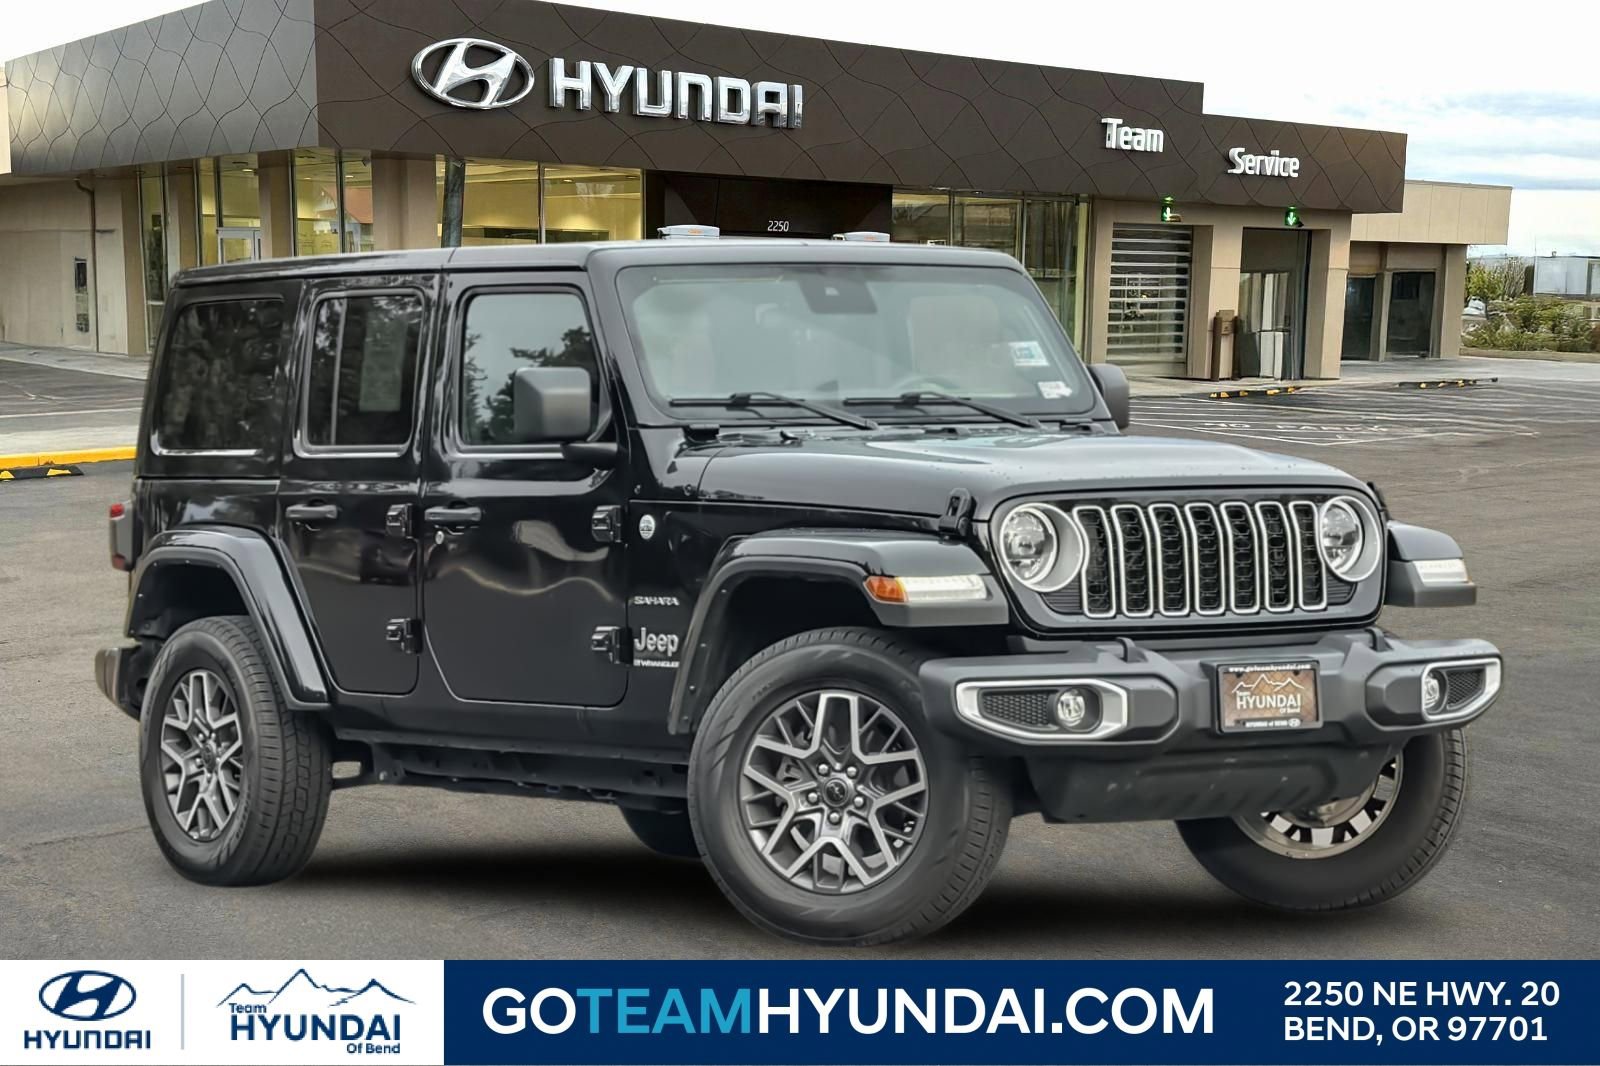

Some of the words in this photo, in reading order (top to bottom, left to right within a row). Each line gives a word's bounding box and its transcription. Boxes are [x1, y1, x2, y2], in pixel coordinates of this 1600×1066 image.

[548, 57, 804, 129] HYUNDAI
[1101, 117, 1164, 153] Team
[1227, 147, 1300, 178] Service
[767, 219, 790, 232] 2250
[633, 595, 681, 606] SAHARA
[633, 626, 679, 657] Jeep
[1237, 694, 1301, 710] HYUNDAI
